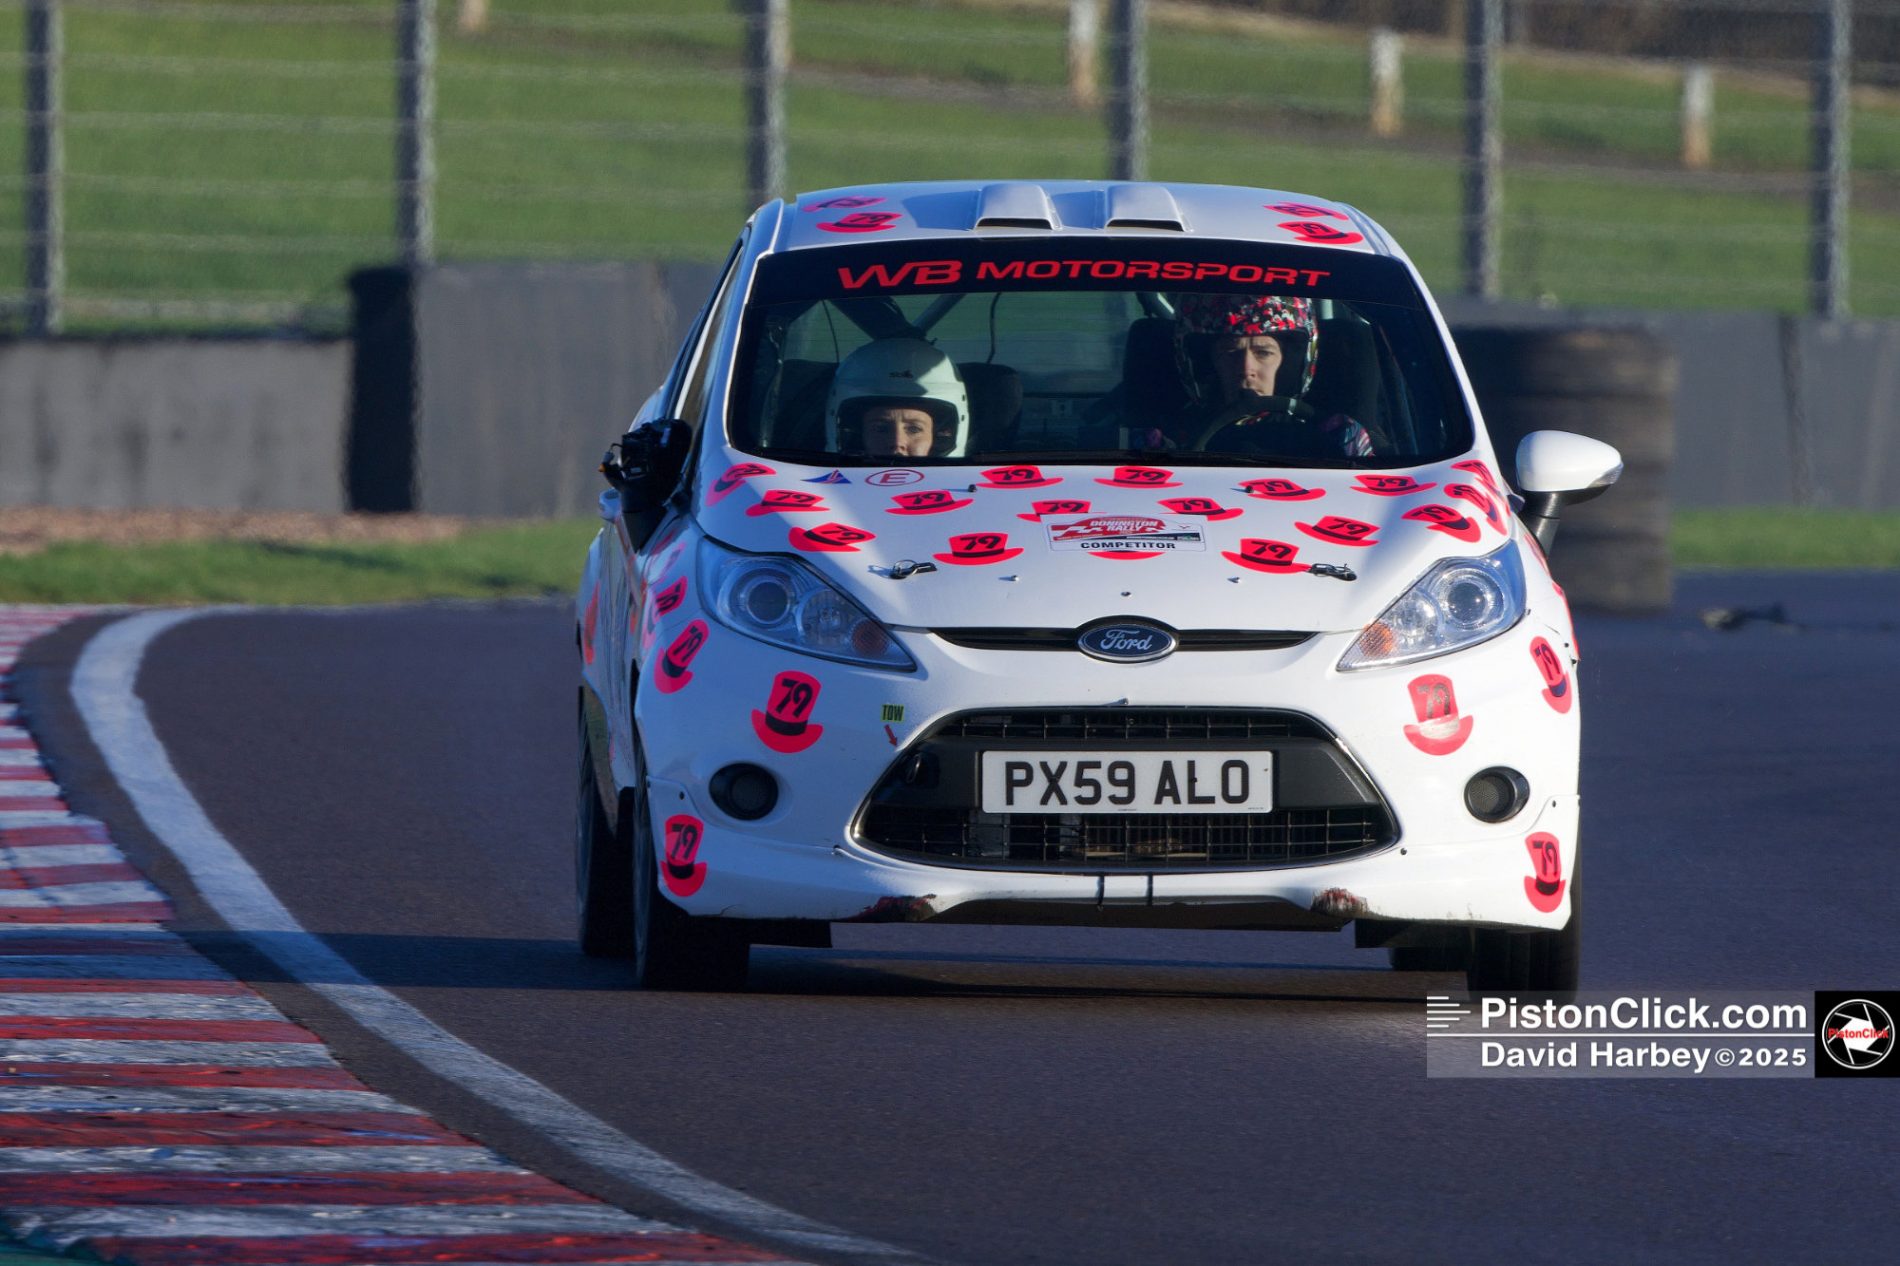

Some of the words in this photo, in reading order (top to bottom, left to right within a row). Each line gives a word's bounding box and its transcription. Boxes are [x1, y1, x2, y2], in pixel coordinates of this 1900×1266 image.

[838, 260, 963, 288] WB
[976, 260, 1331, 287] MOTORSPORT
[880, 473, 910, 483] E
[992, 469, 1035, 480] 79
[1125, 469, 1166, 481] 79
[1366, 476, 1408, 487] 79
[1250, 480, 1295, 491] 79
[776, 491, 816, 502] 79
[902, 492, 946, 504] 79
[1042, 501, 1085, 513] 79
[1168, 499, 1213, 511] 79
[1410, 506, 1456, 520] 79
[821, 526, 866, 540] 79
[1327, 518, 1370, 535] 79
[960, 535, 1002, 550] 79
[1080, 541, 1176, 549] COMPETITOR
[1251, 540, 1292, 559] 79
[673, 625, 704, 663] 79
[1100, 629, 1153, 650] Ford
[1534, 644, 1561, 681] 79
[775, 678, 813, 718] 79
[1417, 682, 1450, 719] 79
[882, 704, 904, 721] TOW
[1005, 760, 1136, 806] PX59
[1154, 759, 1250, 805] ALO
[671, 824, 698, 860] 79
[1532, 840, 1559, 877] 79
